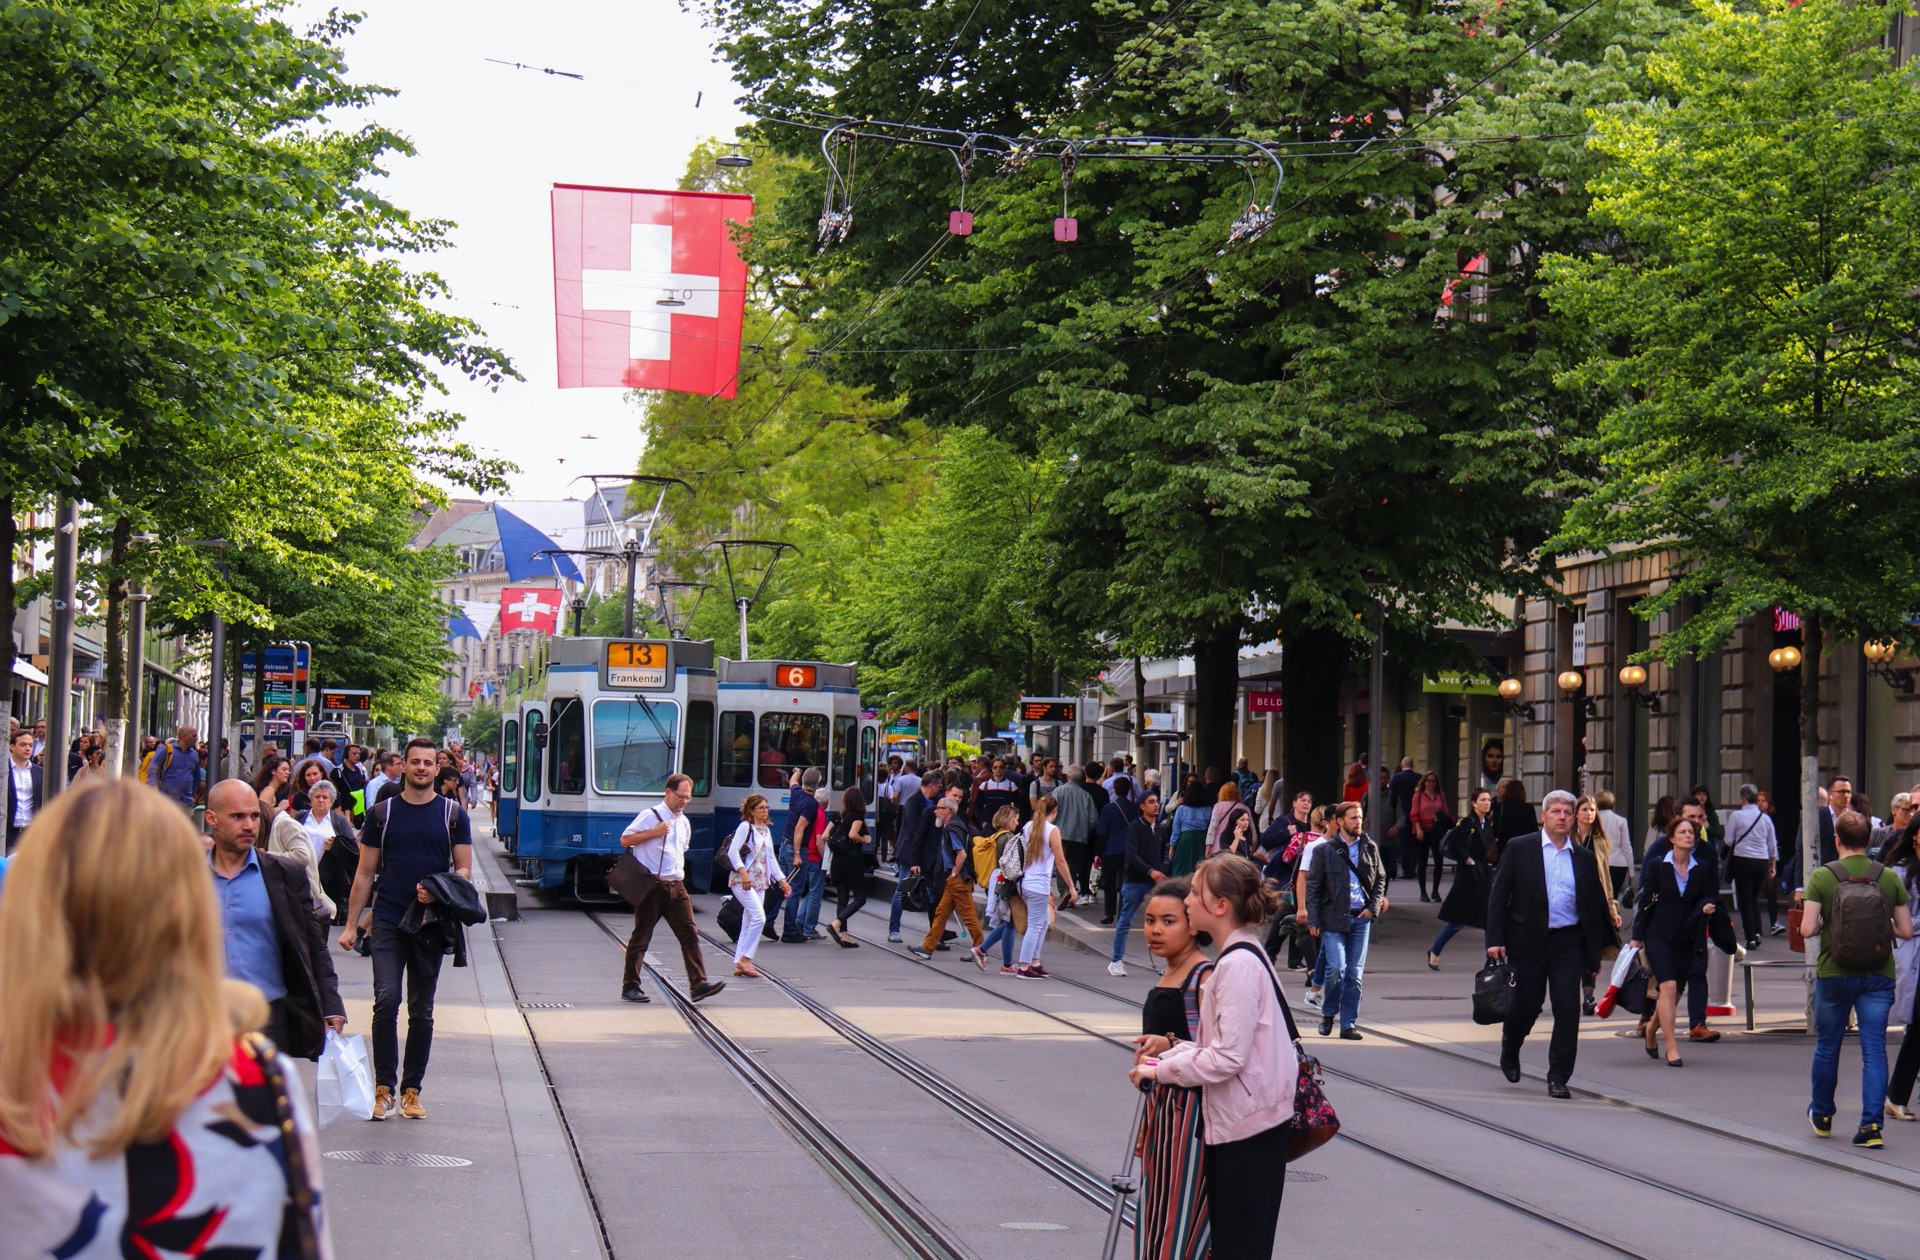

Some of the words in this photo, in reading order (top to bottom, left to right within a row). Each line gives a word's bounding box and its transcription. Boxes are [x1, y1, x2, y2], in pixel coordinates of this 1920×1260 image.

[624, 644, 652, 665] 13
[243, 663, 288, 671] Bahnfstrasse
[611, 674, 662, 683] Frankental
[789, 667, 804, 687] 6
